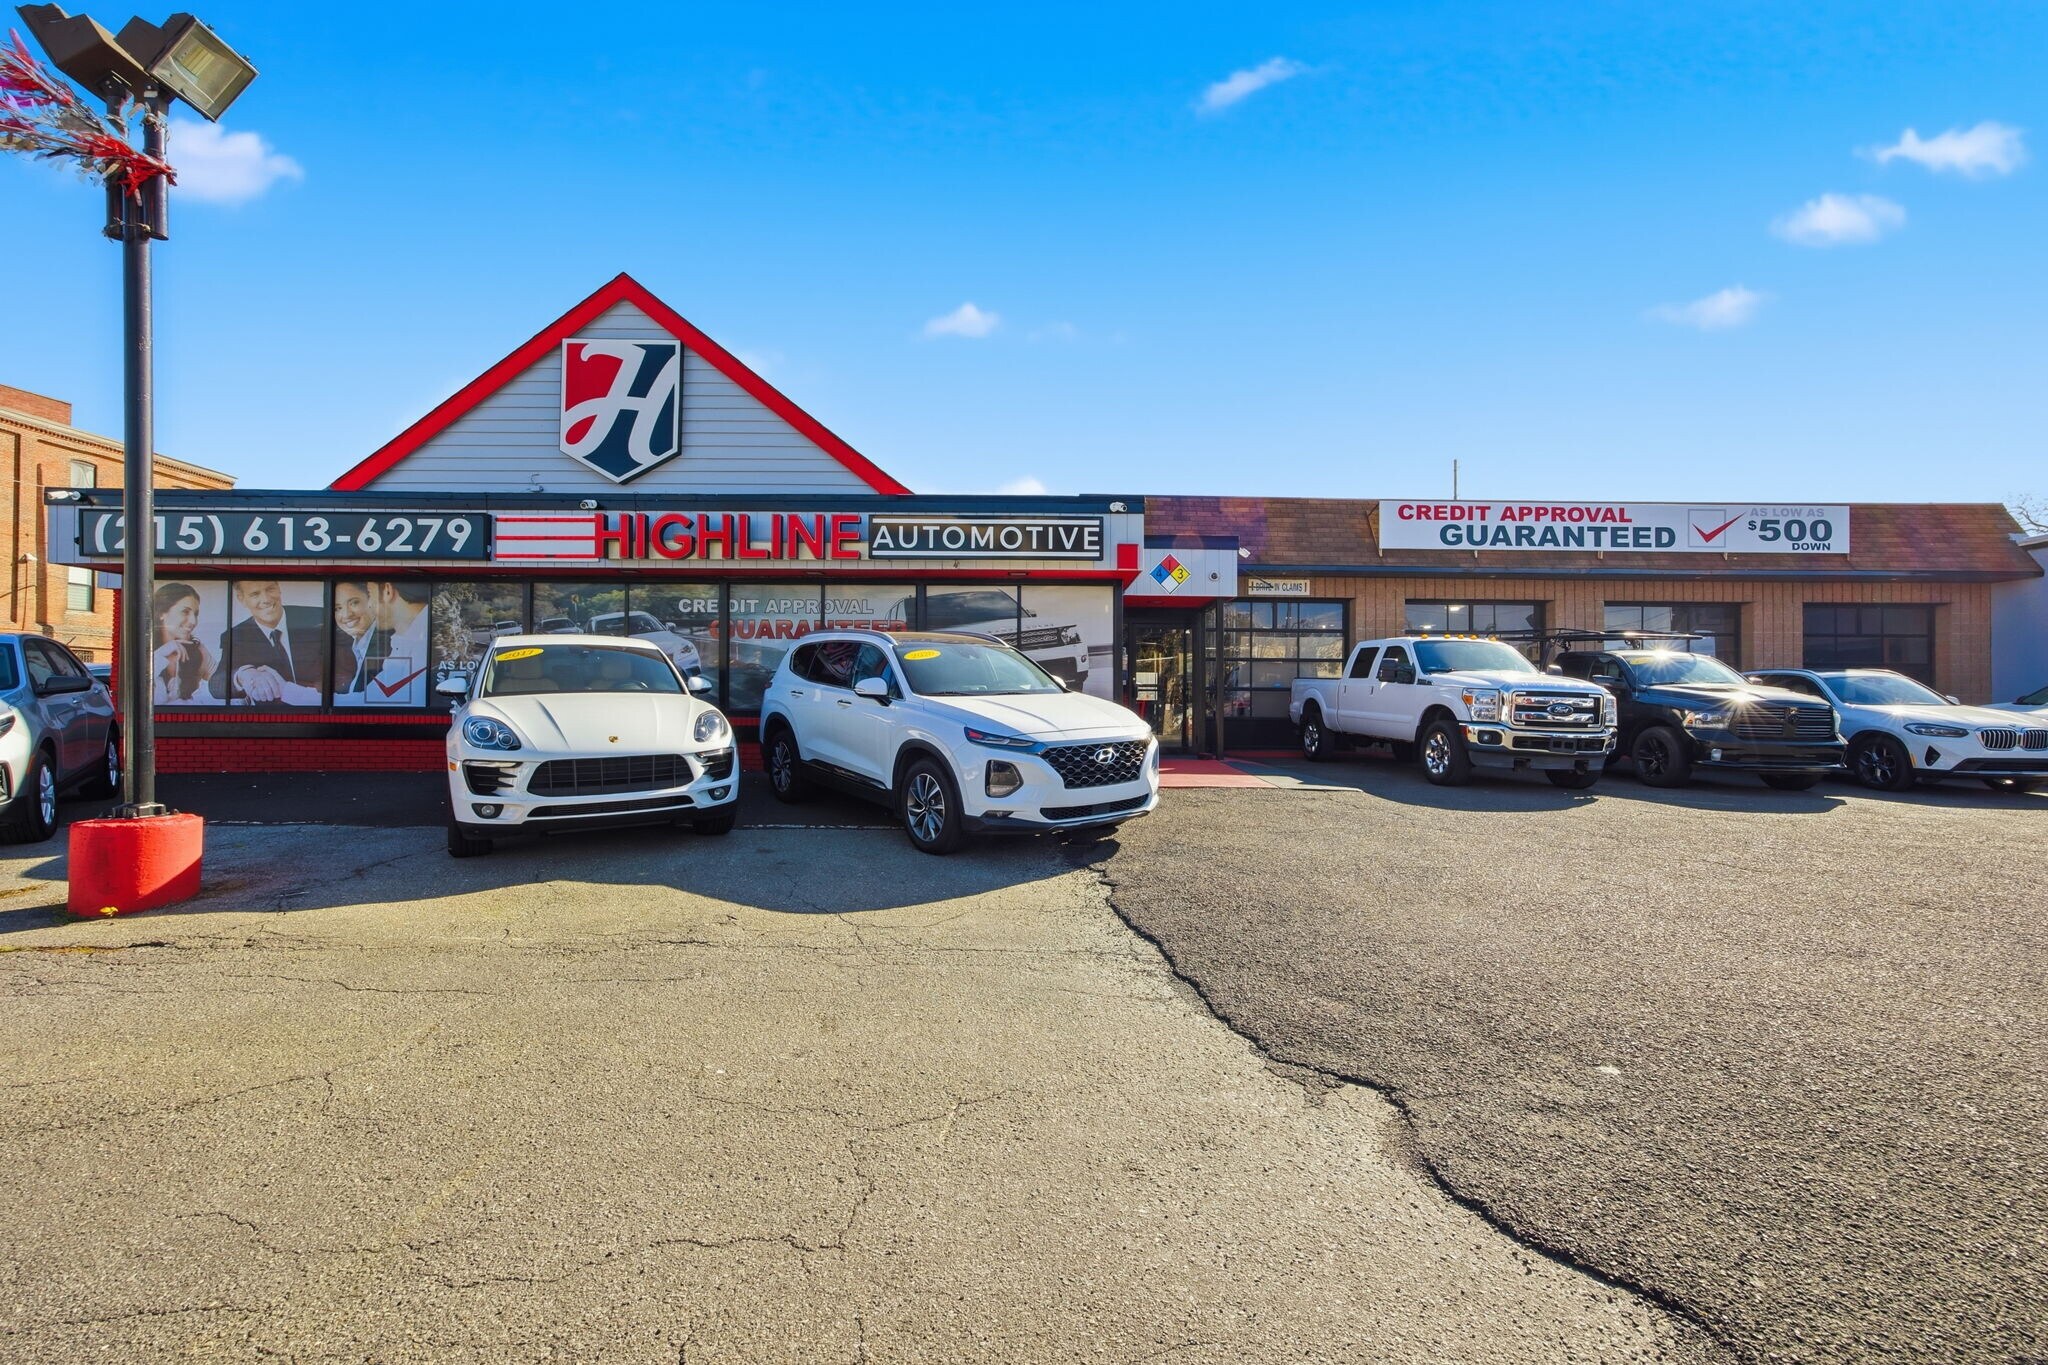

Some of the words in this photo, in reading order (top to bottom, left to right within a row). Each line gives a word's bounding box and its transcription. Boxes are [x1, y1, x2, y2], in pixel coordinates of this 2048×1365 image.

[1397, 504, 1491, 521] CREDIT
[1500, 506, 1632, 523] APPROVAL
[1750, 508, 1768, 517] AS
[1773, 508, 1802, 517] LOW
[1806, 508, 1824, 517] AS
[243, 516, 472, 552] 613-6279
[594, 512, 862, 560] HIGHLINE
[872, 525, 1100, 550] AUTOMOTIVE
[1439, 524, 1676, 548] GUARANTEED
[1748, 519, 1833, 542] $500
[1792, 542, 1831, 551] DOWN
[1176, 568, 1184, 580] 3
[1281, 582, 1303, 592] CLAIMS
[678, 599, 759, 613] CREDIT
[765, 599, 874, 614] APPROVAL
[438, 661, 455, 670] AS
